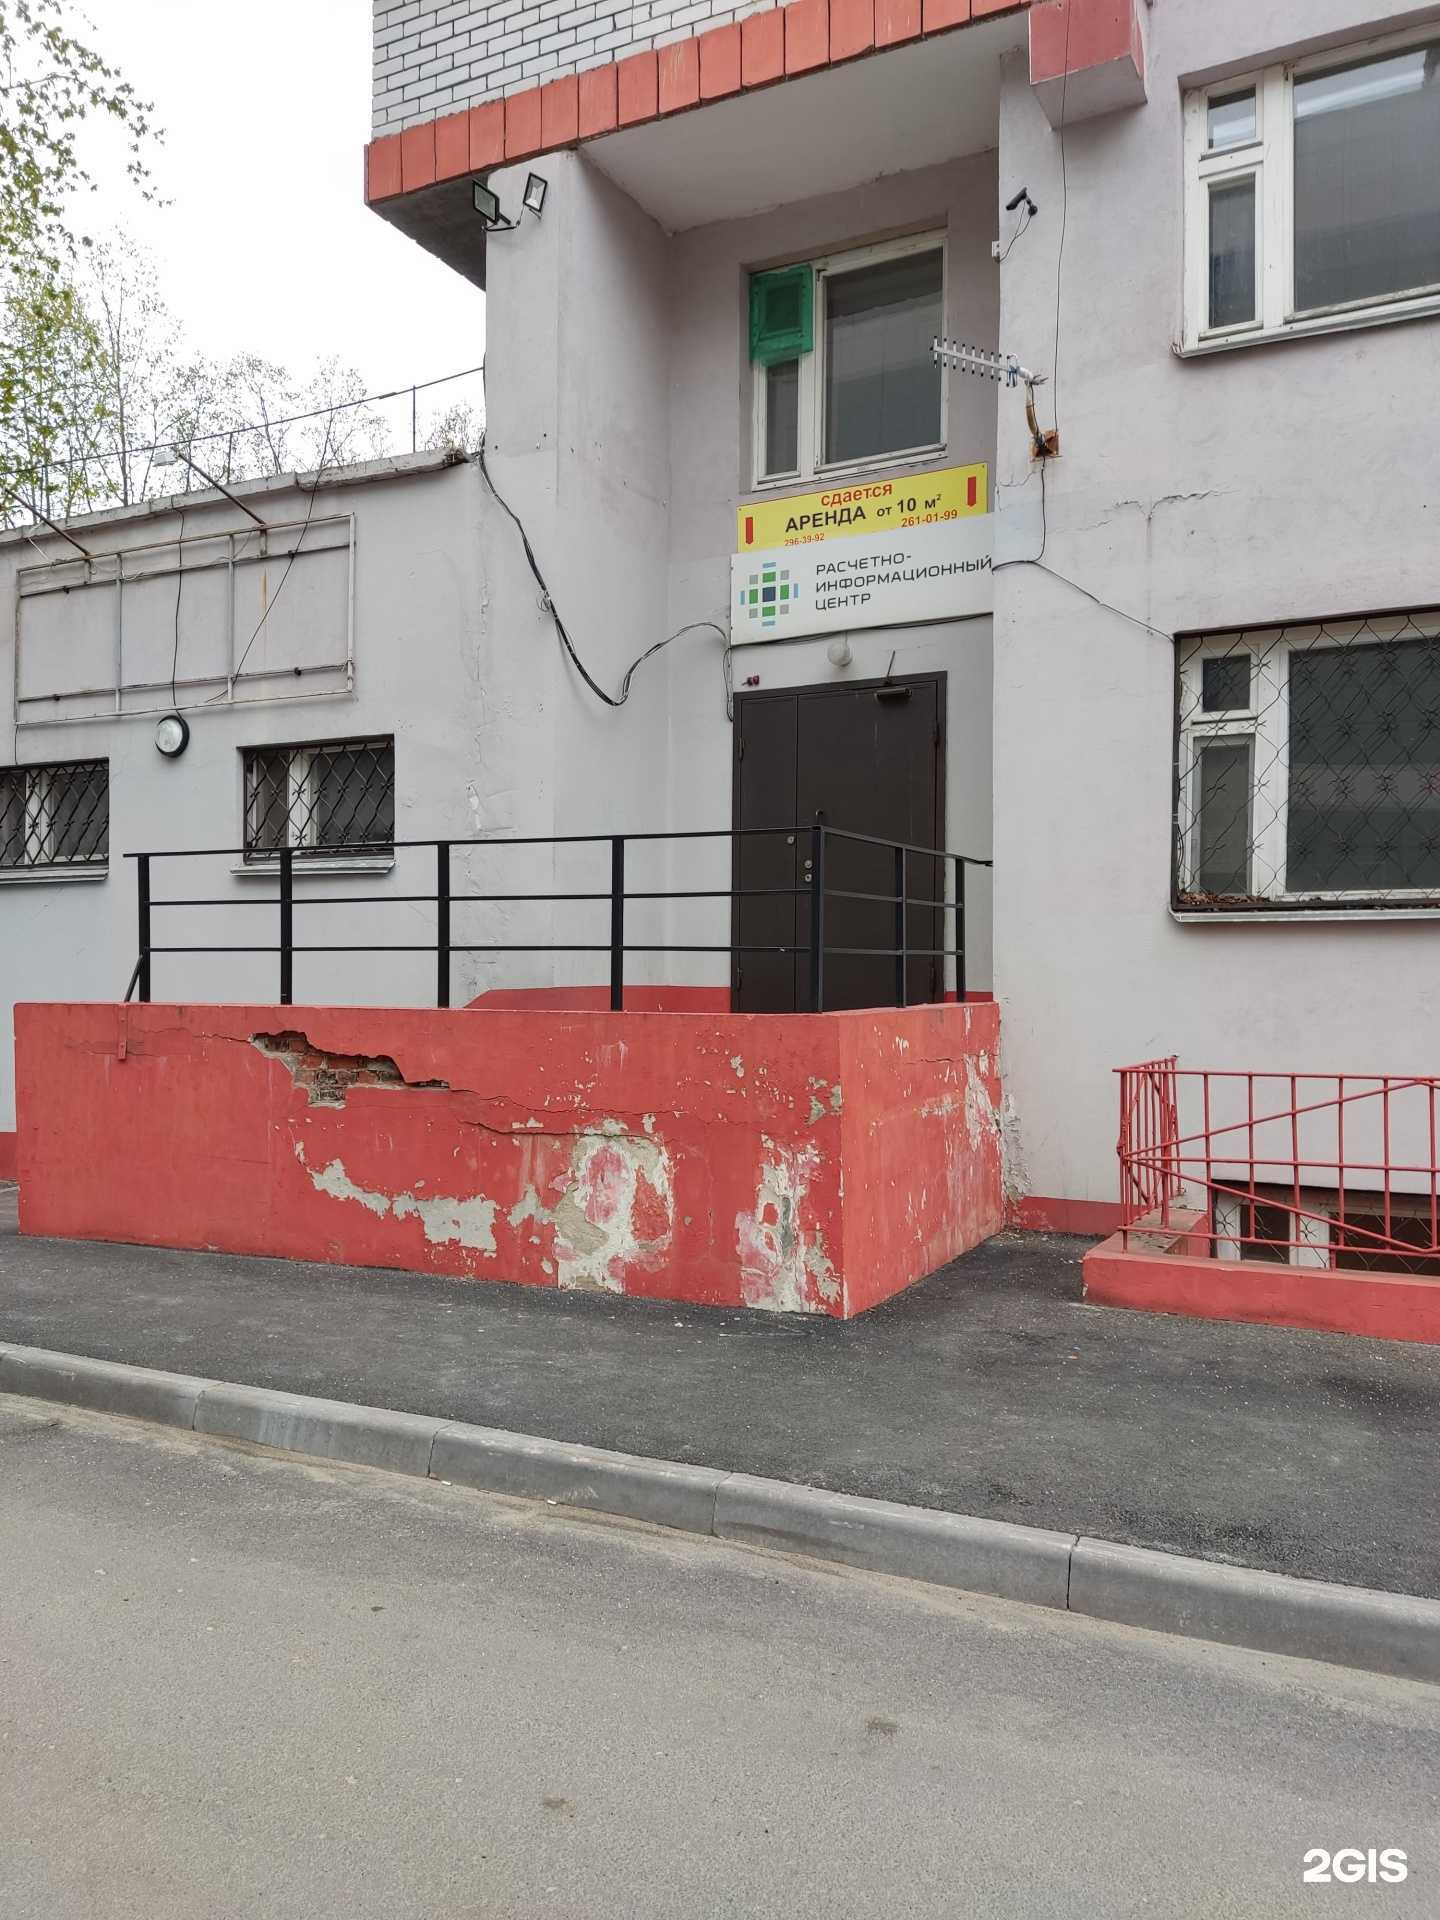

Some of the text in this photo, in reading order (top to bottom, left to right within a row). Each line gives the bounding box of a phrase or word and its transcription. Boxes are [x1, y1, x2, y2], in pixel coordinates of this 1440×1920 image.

[821, 484, 893, 507] сдается
[785, 506, 866, 532] АРЕНДА
[876, 506, 892, 517] от
[897, 497, 917, 513] 10
[901, 509, 958, 528] 261-01-99
[784, 532, 825, 546] 296-39-92
[815, 555, 993, 593] ИНФОРМАЦИОННЫЙ
[816, 552, 912, 576] РАСЧЕТНО-
[815, 593, 872, 611] ЦЕНТР
